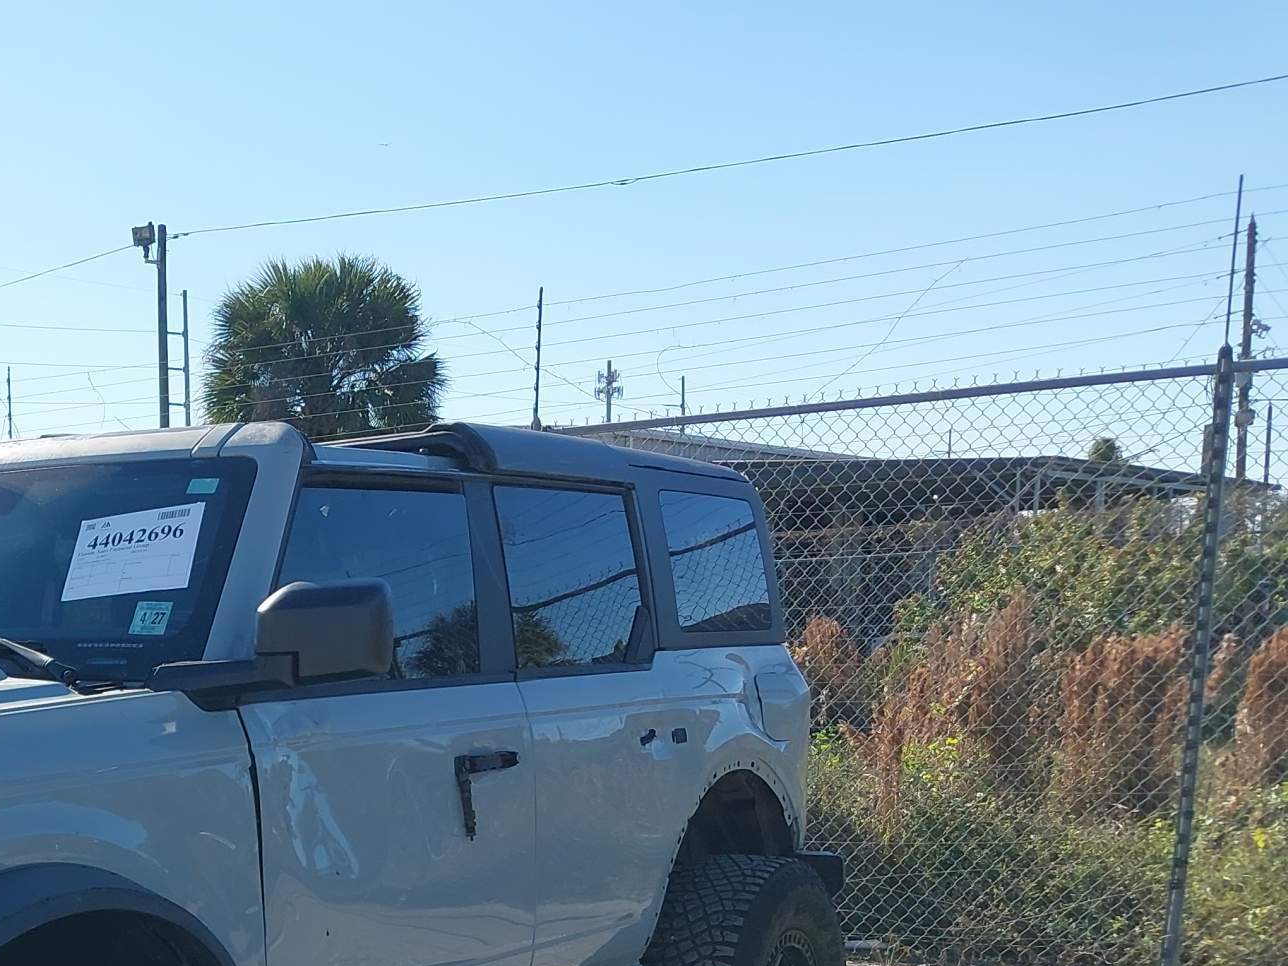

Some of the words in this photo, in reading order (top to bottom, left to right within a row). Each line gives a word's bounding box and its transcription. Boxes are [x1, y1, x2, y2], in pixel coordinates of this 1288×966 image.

[88, 522, 185, 550] 44042696
[139, 612, 148, 625] 4
[151, 612, 166, 625] 27
